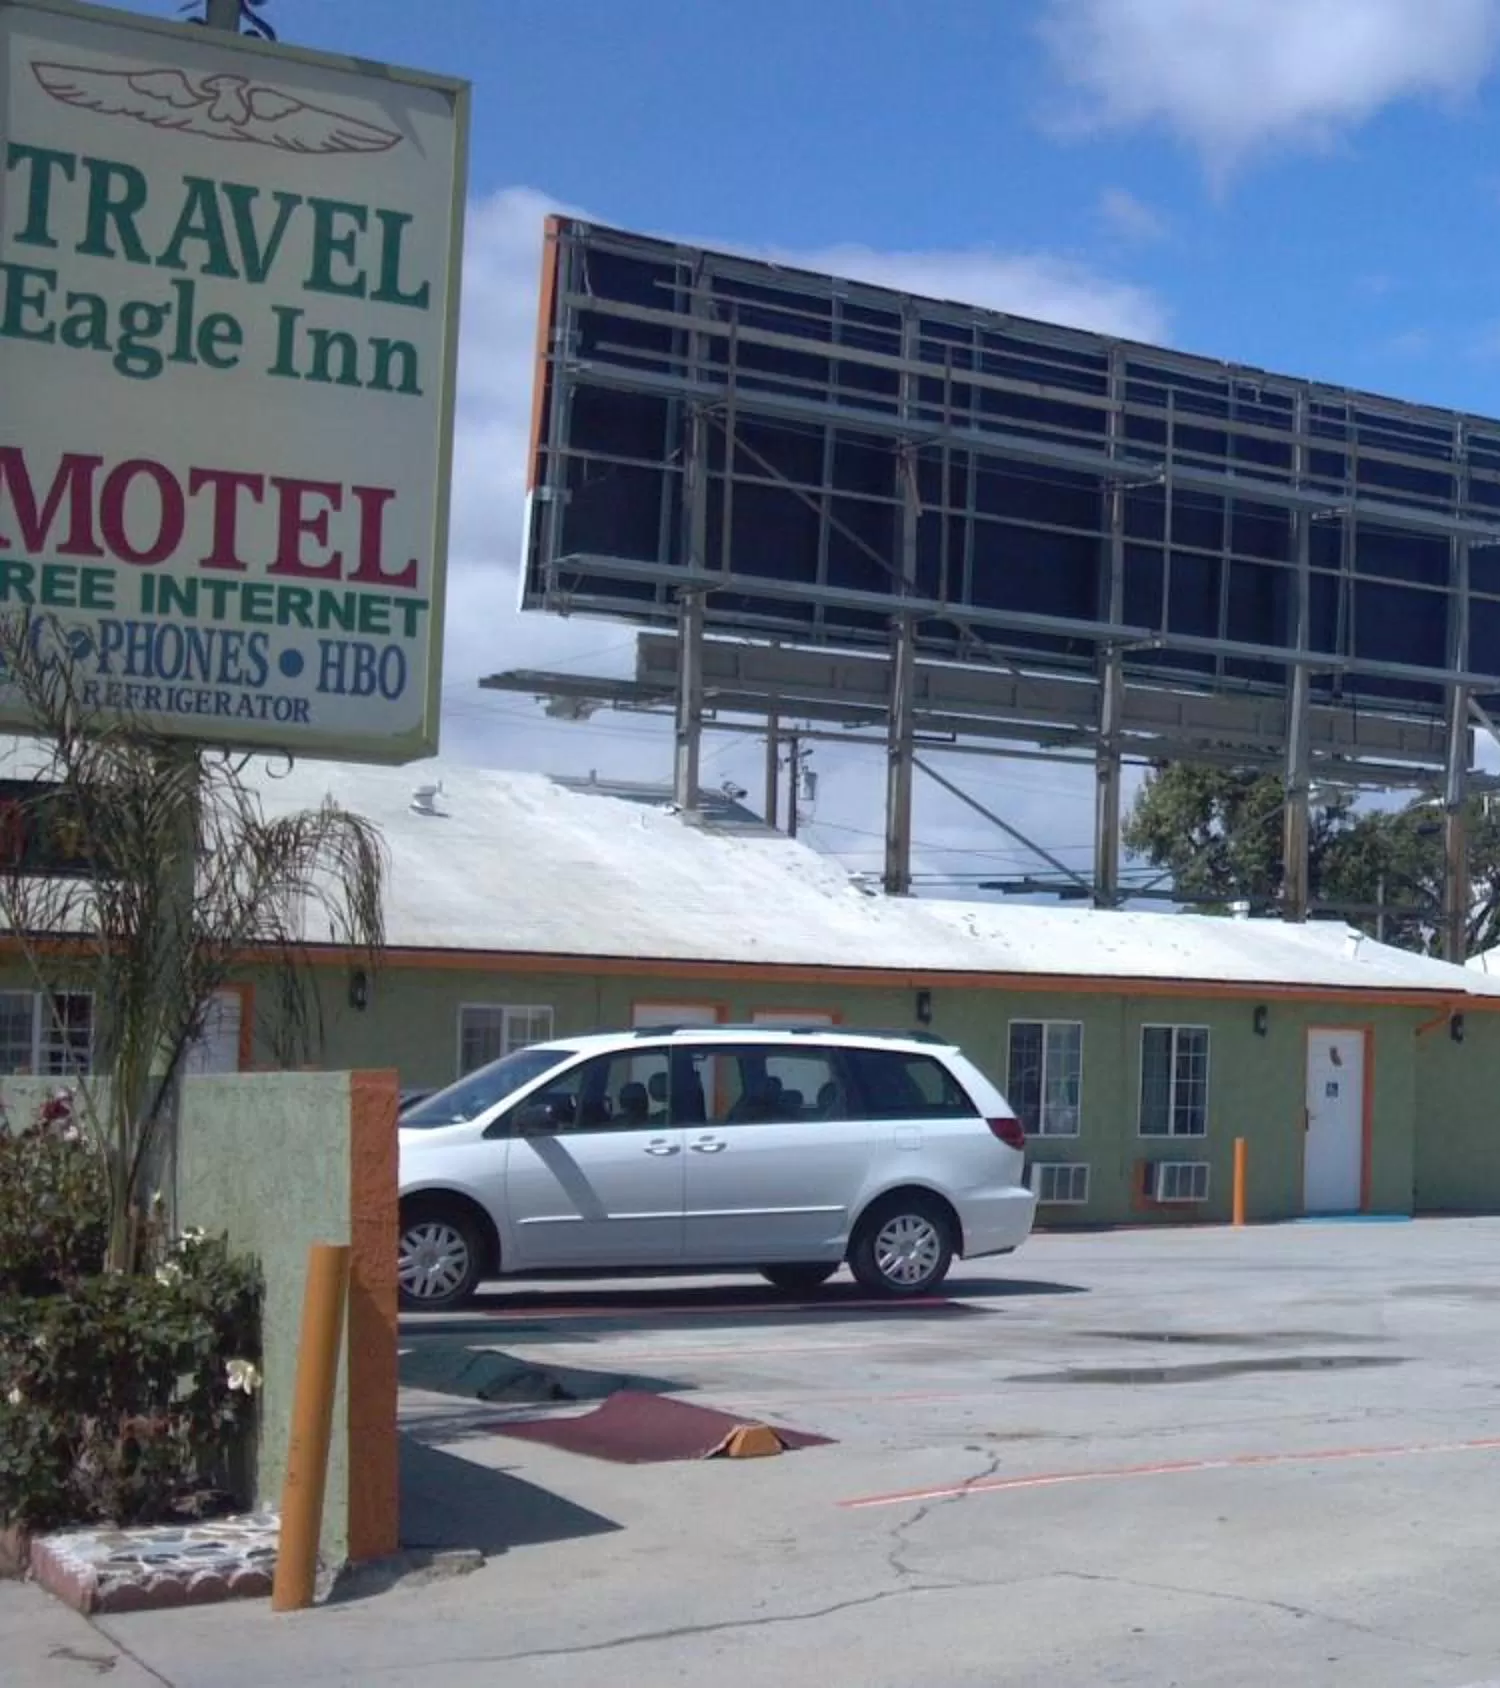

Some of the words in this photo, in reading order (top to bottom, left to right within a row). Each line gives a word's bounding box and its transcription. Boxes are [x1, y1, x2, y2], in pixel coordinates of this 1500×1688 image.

[7, 142, 430, 310] TRAVEL
[0, 262, 243, 380] Eagle
[266, 304, 424, 396] Inn
[0, 445, 418, 589] MOTEL
[0, 560, 117, 610] REE
[140, 573, 429, 638] INTERNET
[82, 680, 311, 724] REFRIGERATOR
[97, 619, 270, 688] PHONES
[315, 639, 407, 700] HBO
